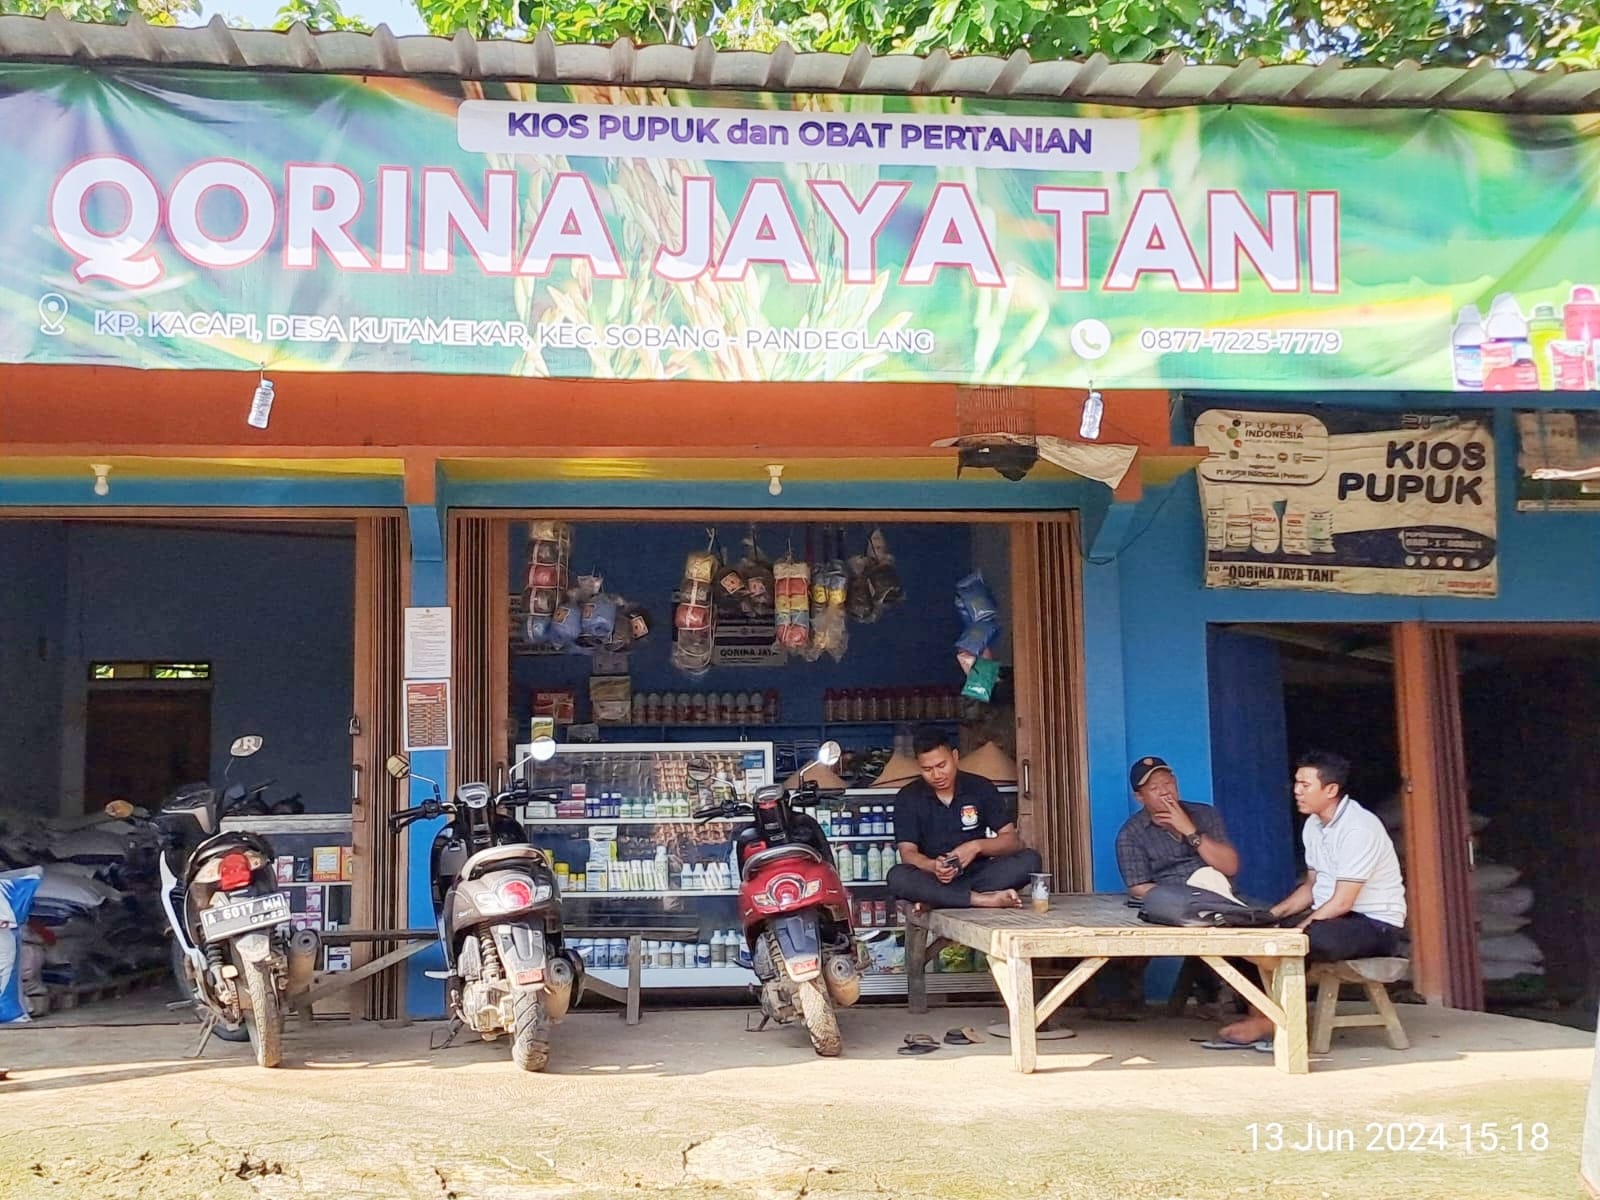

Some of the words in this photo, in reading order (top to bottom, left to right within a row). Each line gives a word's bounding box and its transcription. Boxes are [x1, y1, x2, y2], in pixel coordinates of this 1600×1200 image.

[507, 111, 589, 140] KIOS
[599, 113, 721, 144] PUPUK
[726, 117, 788, 146] dan
[798, 121, 893, 149] OBAT
[900, 123, 1093, 155] PERTANIAN
[50, 153, 626, 286] QORINA
[654, 175, 1006, 285] JAYA
[1033, 185, 1340, 294] TANI
[96, 312, 142, 336] KP.
[151, 313, 261, 343] KACAPI,
[268, 316, 341, 342] DESA
[352, 318, 532, 347] KUTAMEKAR,
[539, 324, 598, 346] KEC.
[605, 325, 721, 349] SOBANG
[745, 328, 932, 352] PANDEGLANG
[1140, 329, 1340, 352] 0877-7225-7779
[1245, 430, 1304, 439] INDONESIA
[1386, 440, 1486, 471] KIOS
[1338, 472, 1483, 505] PUPUK
[1277, 566, 1304, 581] JAYA
[720, 648, 755, 657] QORINA
[208, 912, 217, 925] A
[222, 902, 254, 920] 6017
